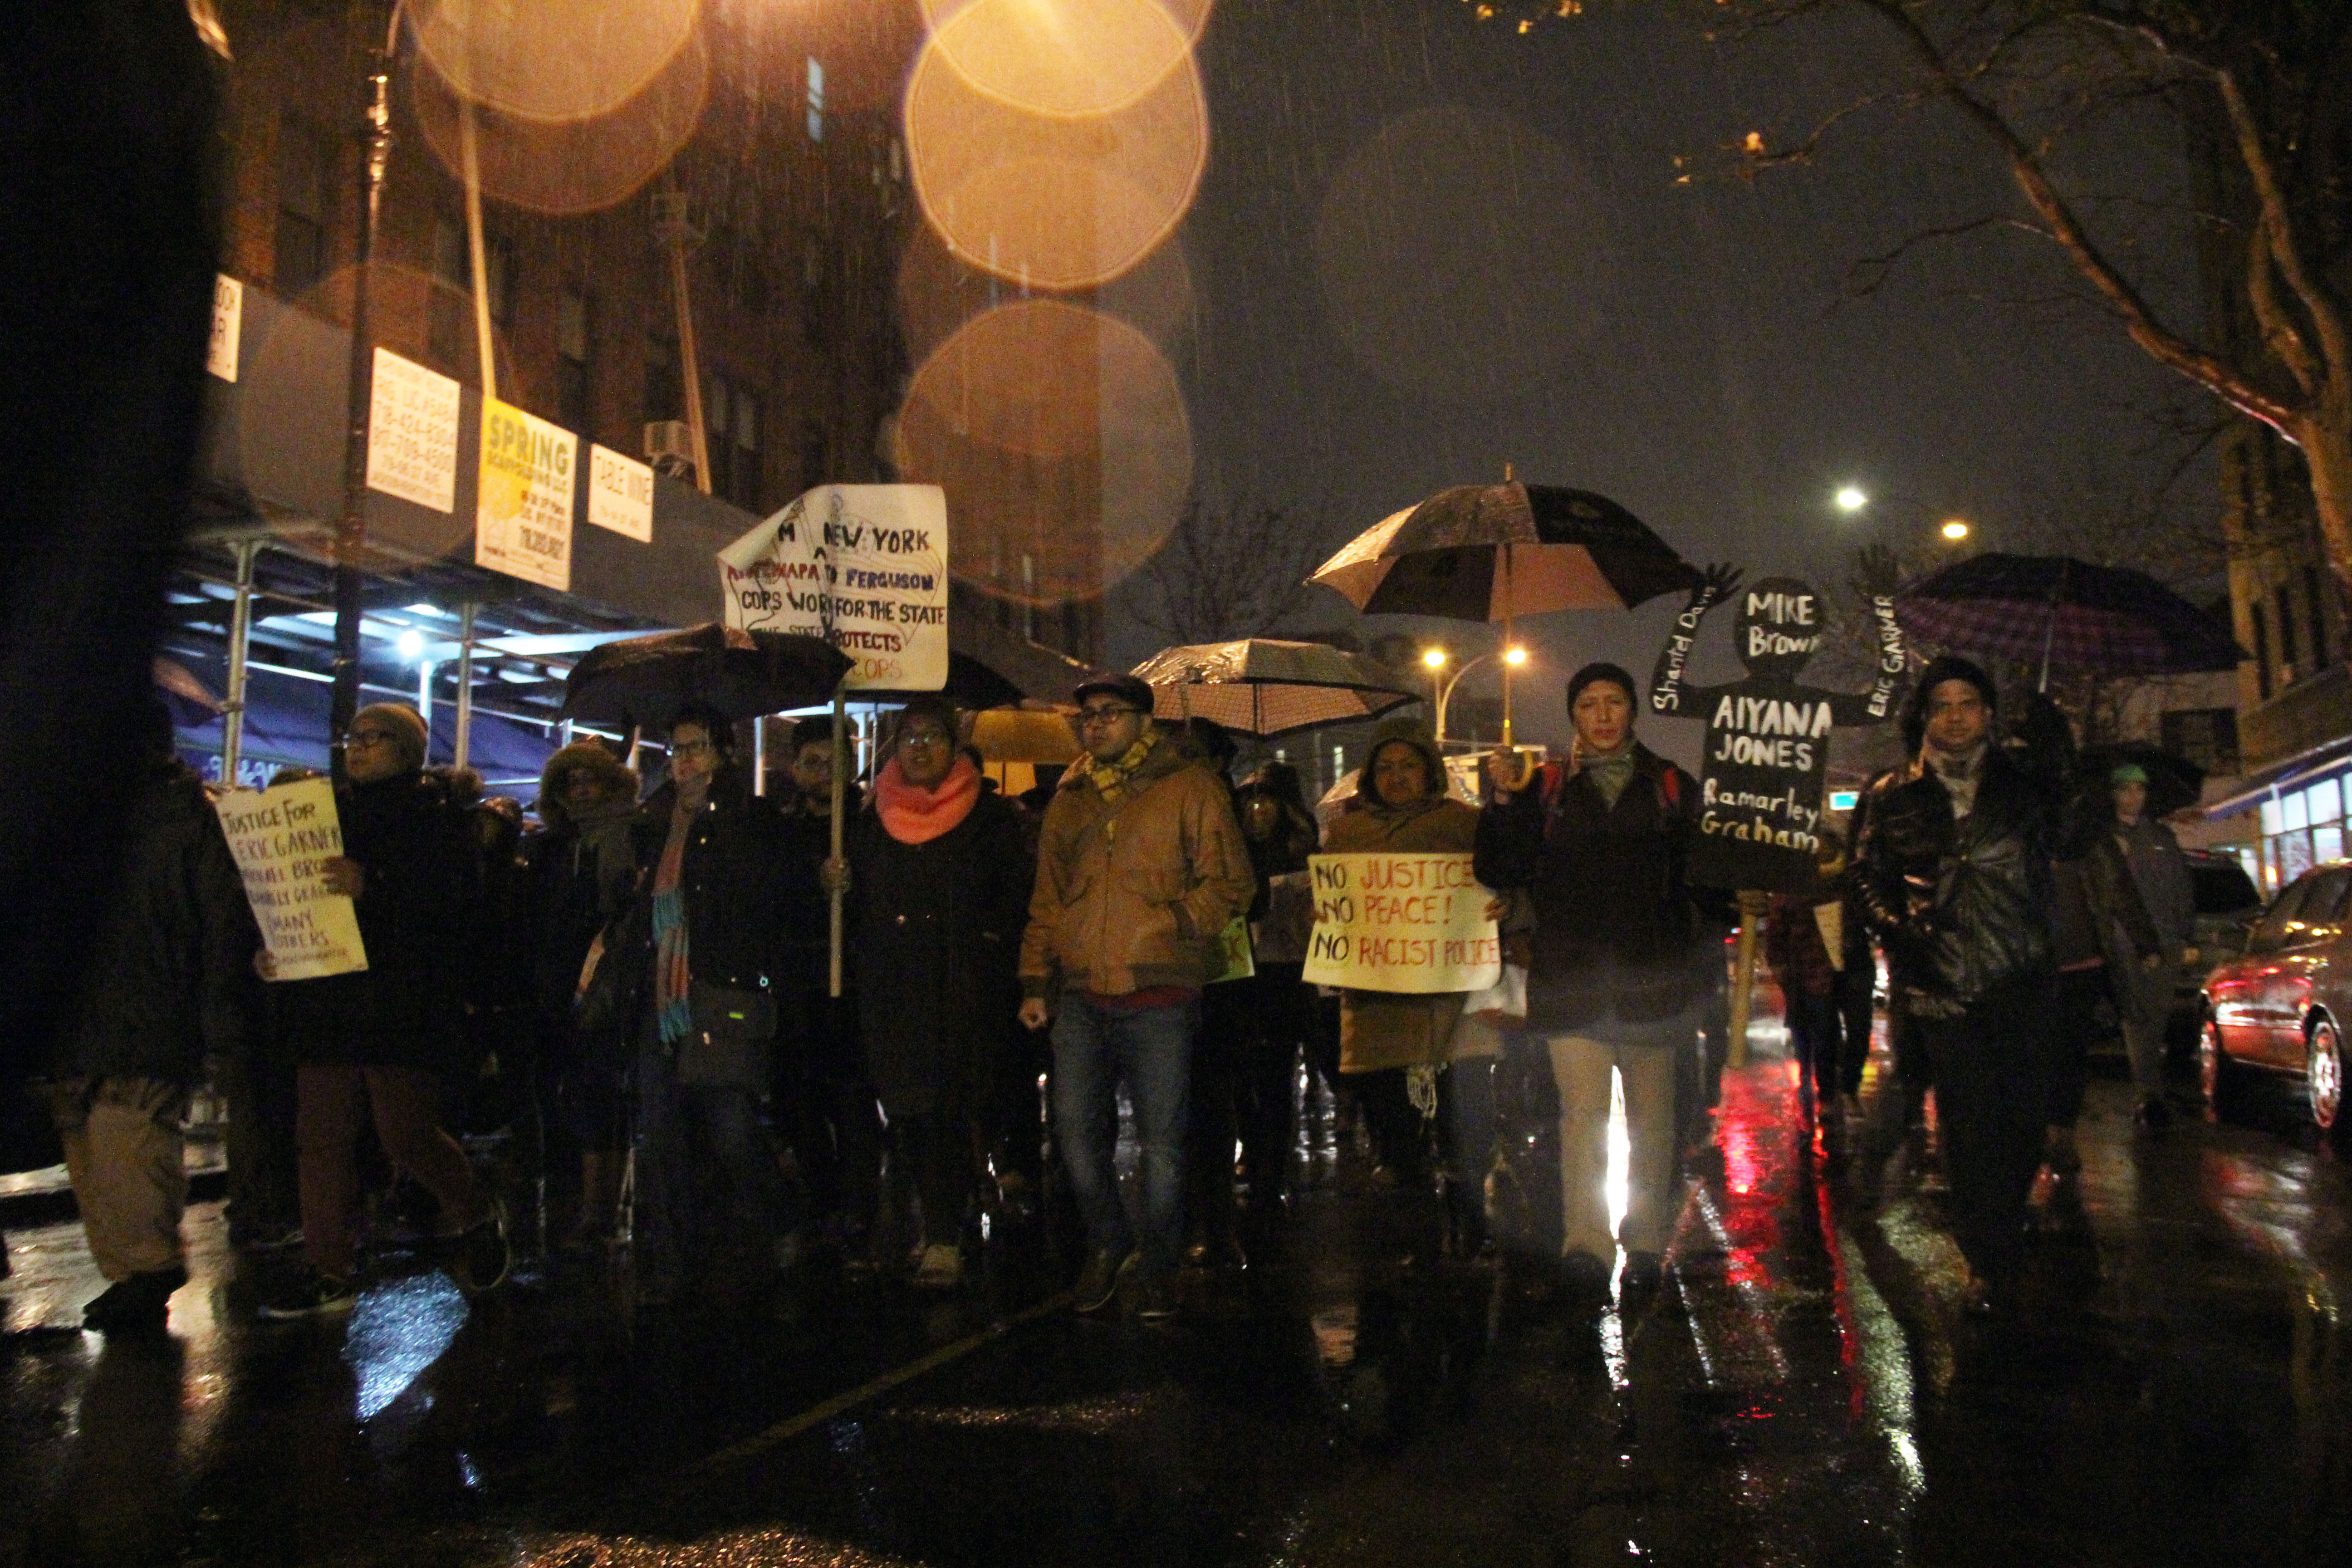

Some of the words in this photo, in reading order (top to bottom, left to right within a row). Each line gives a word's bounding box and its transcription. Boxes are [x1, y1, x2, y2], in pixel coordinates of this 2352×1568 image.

[490, 414, 569, 476] SPRING
[823, 522, 863, 548] NEW
[872, 526, 930, 554] YORK
[846, 568, 934, 591] FERGUSON
[742, 591, 782, 611] COPS
[835, 597, 865, 617] FOR
[867, 600, 896, 621] THE
[900, 603, 946, 625] STATE
[1747, 592, 1814, 625] MIKE
[1874, 595, 1905, 673] GARNER
[1653, 635, 1693, 711] Shantel
[1868, 677, 1894, 717] ERIC
[1713, 695, 1833, 739] AIYANA
[1714, 734, 1814, 771] JONES
[1704, 778, 1819, 833] Ramarley
[1701, 811, 1819, 854] Graham
[1316, 863, 1348, 890] NO
[1361, 859, 1475, 890] JUSTICE
[1322, 896, 1354, 923] NO
[1363, 895, 1452, 925] PEACE!
[1314, 932, 1350, 961] NO
[1358, 936, 1437, 968] RACIST
